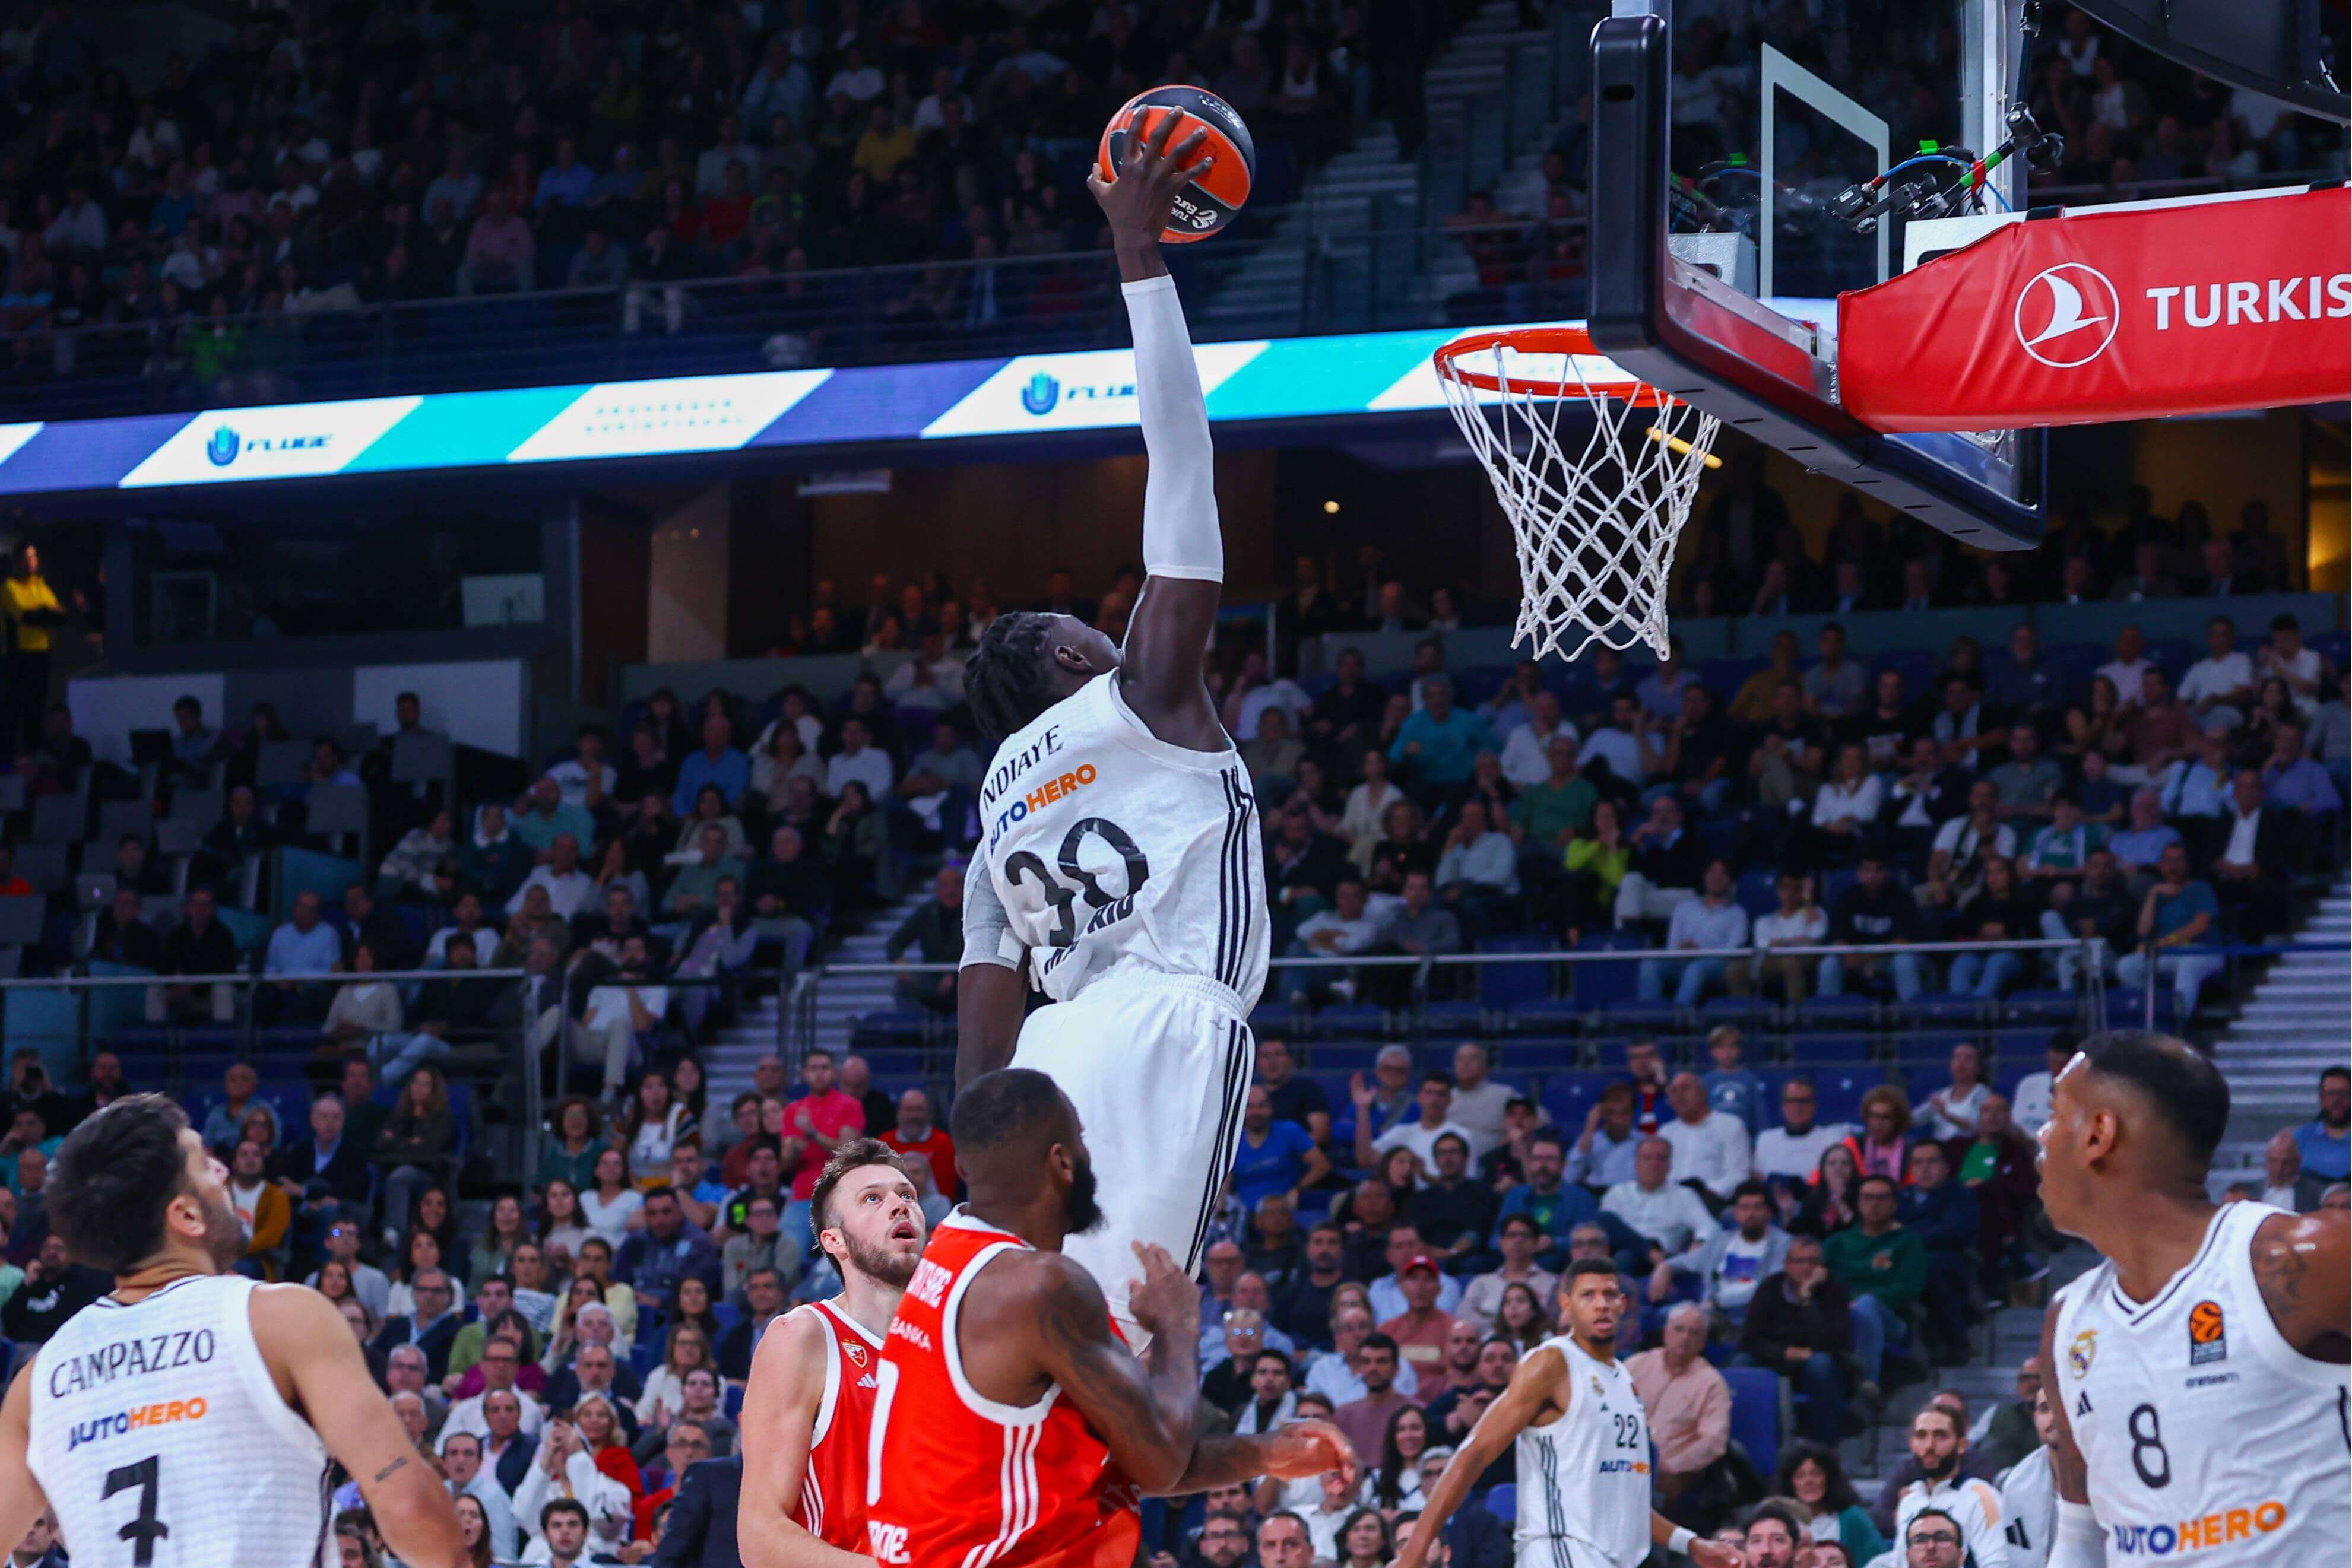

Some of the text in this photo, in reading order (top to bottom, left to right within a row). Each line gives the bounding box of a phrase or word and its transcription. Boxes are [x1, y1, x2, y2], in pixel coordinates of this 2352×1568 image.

[2145, 273, 2352, 331] TURKIS
[983, 724, 1064, 812] NDIAYE
[1005, 817, 1150, 947] 30
[50, 1329, 215, 1399] CAMPAZZO
[68, 1396, 208, 1452] AUTOHERO
[1614, 1413, 1639, 1448] 22
[2128, 1403, 2172, 1490] 8
[100, 1454, 169, 1568] 7
